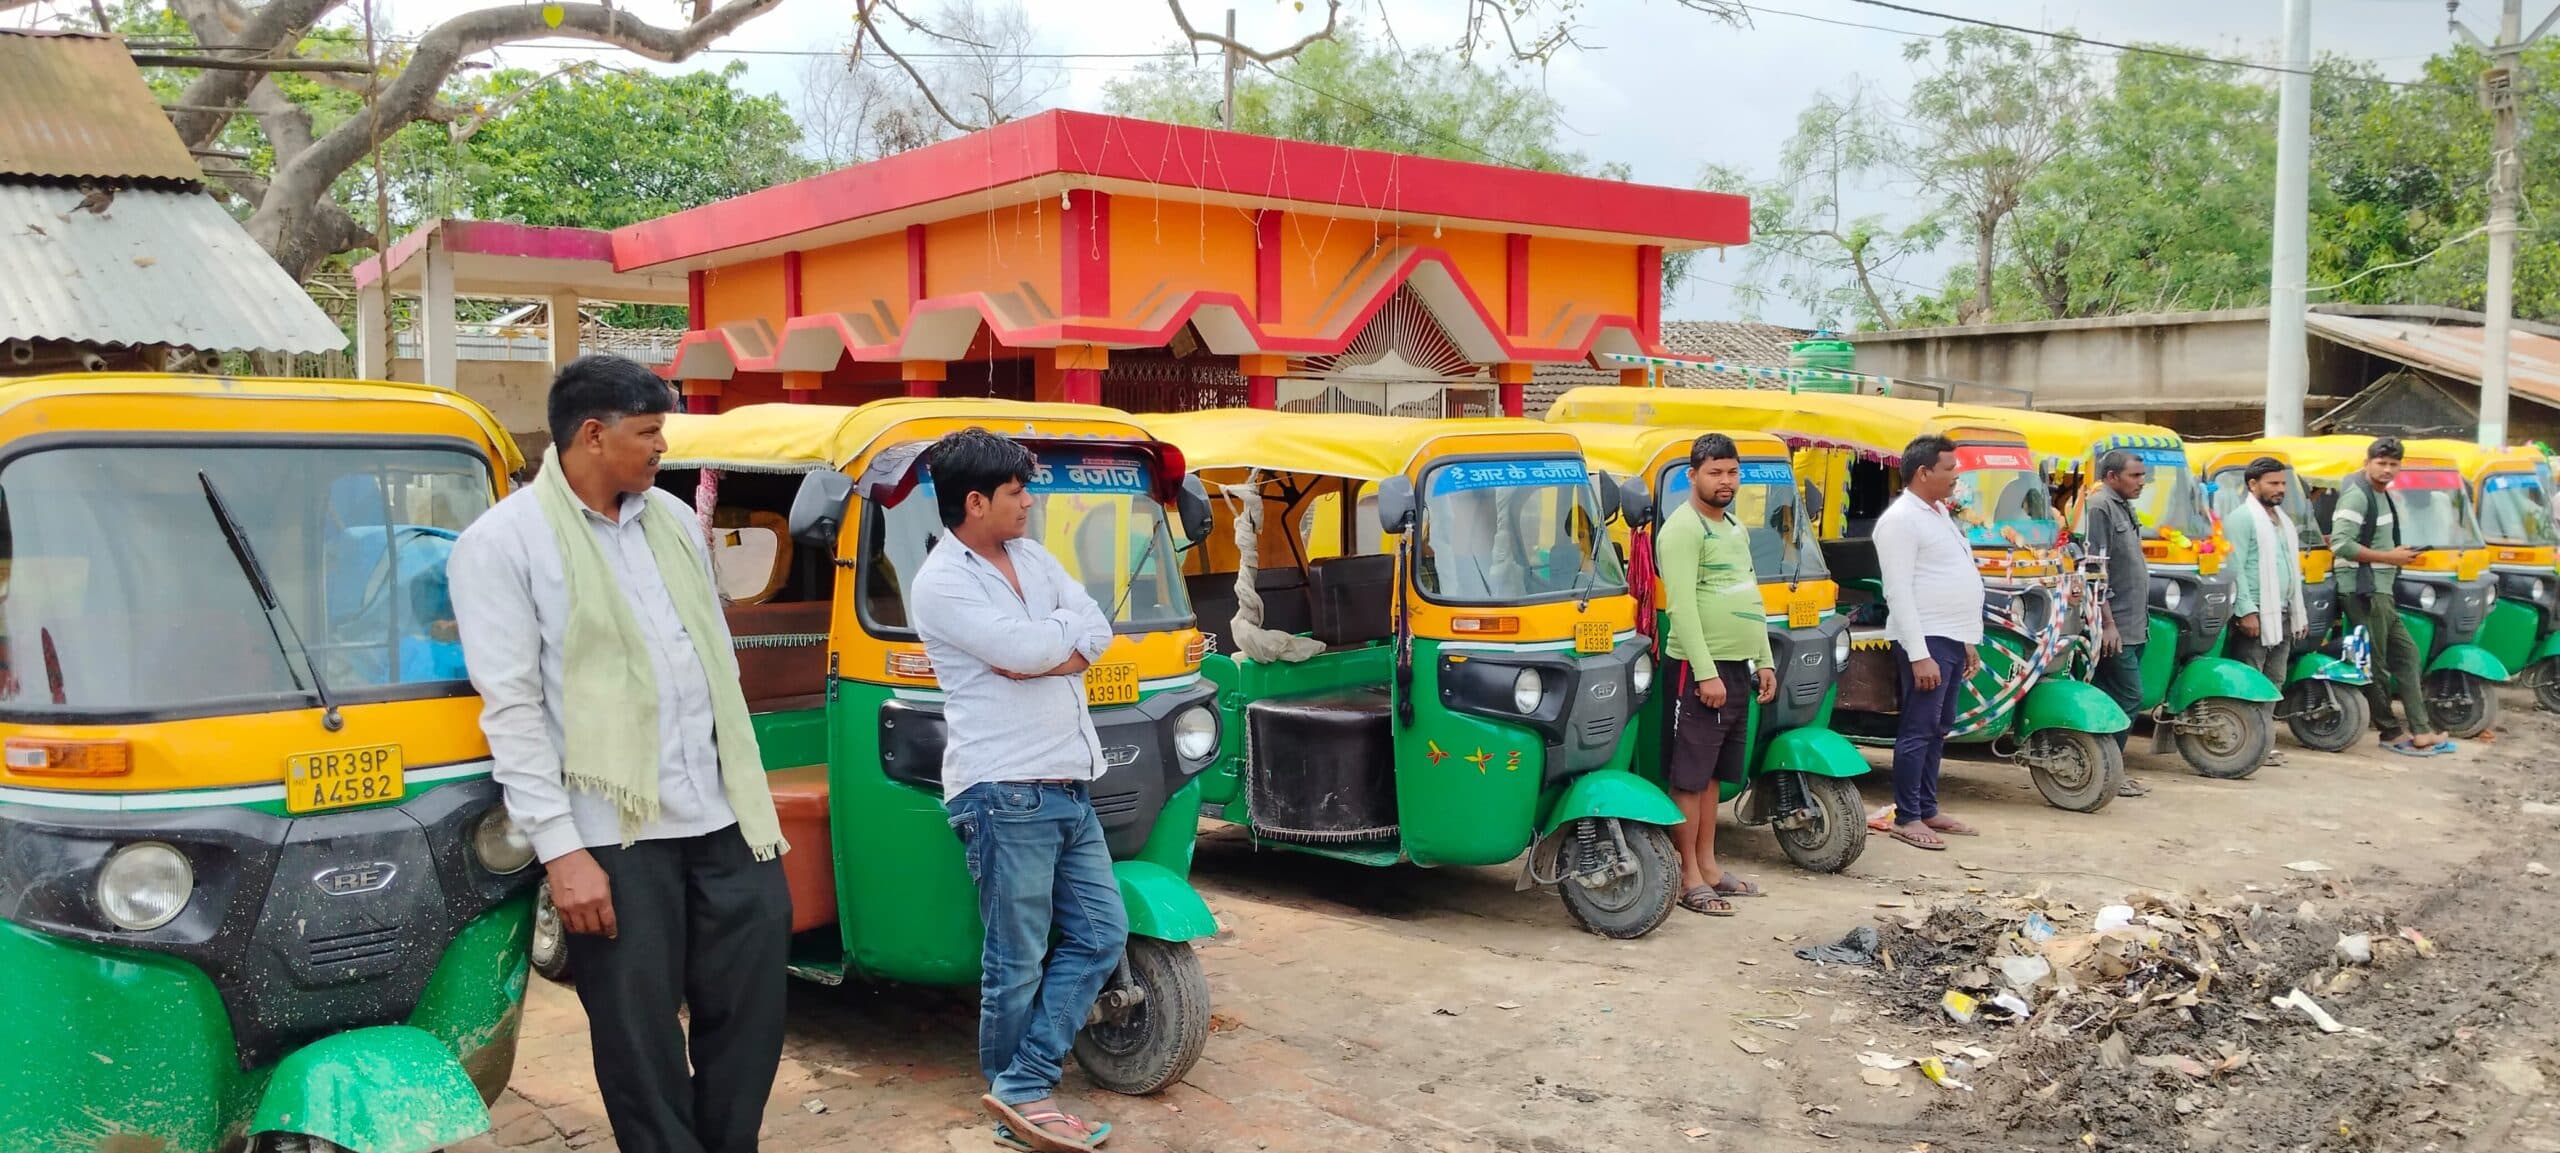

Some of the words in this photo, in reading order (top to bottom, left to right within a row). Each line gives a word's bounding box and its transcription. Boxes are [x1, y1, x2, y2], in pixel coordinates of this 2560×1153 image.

[1066, 464, 1141, 488] बजाज
[1469, 468, 1505, 482] आर
[1506, 463, 1527, 480] के
[1529, 467, 1583, 479] बजाज
[1584, 623, 1608, 637] BR39P
[1584, 637, 1609, 650] A5398
[1087, 665, 1130, 684] BR39P
[1089, 684, 1132, 703] A3910
[309, 750, 388, 779] BR39P
[1104, 751, 1129, 763] RE
[313, 775, 391, 806] A4582
[334, 869, 379, 890] RE
